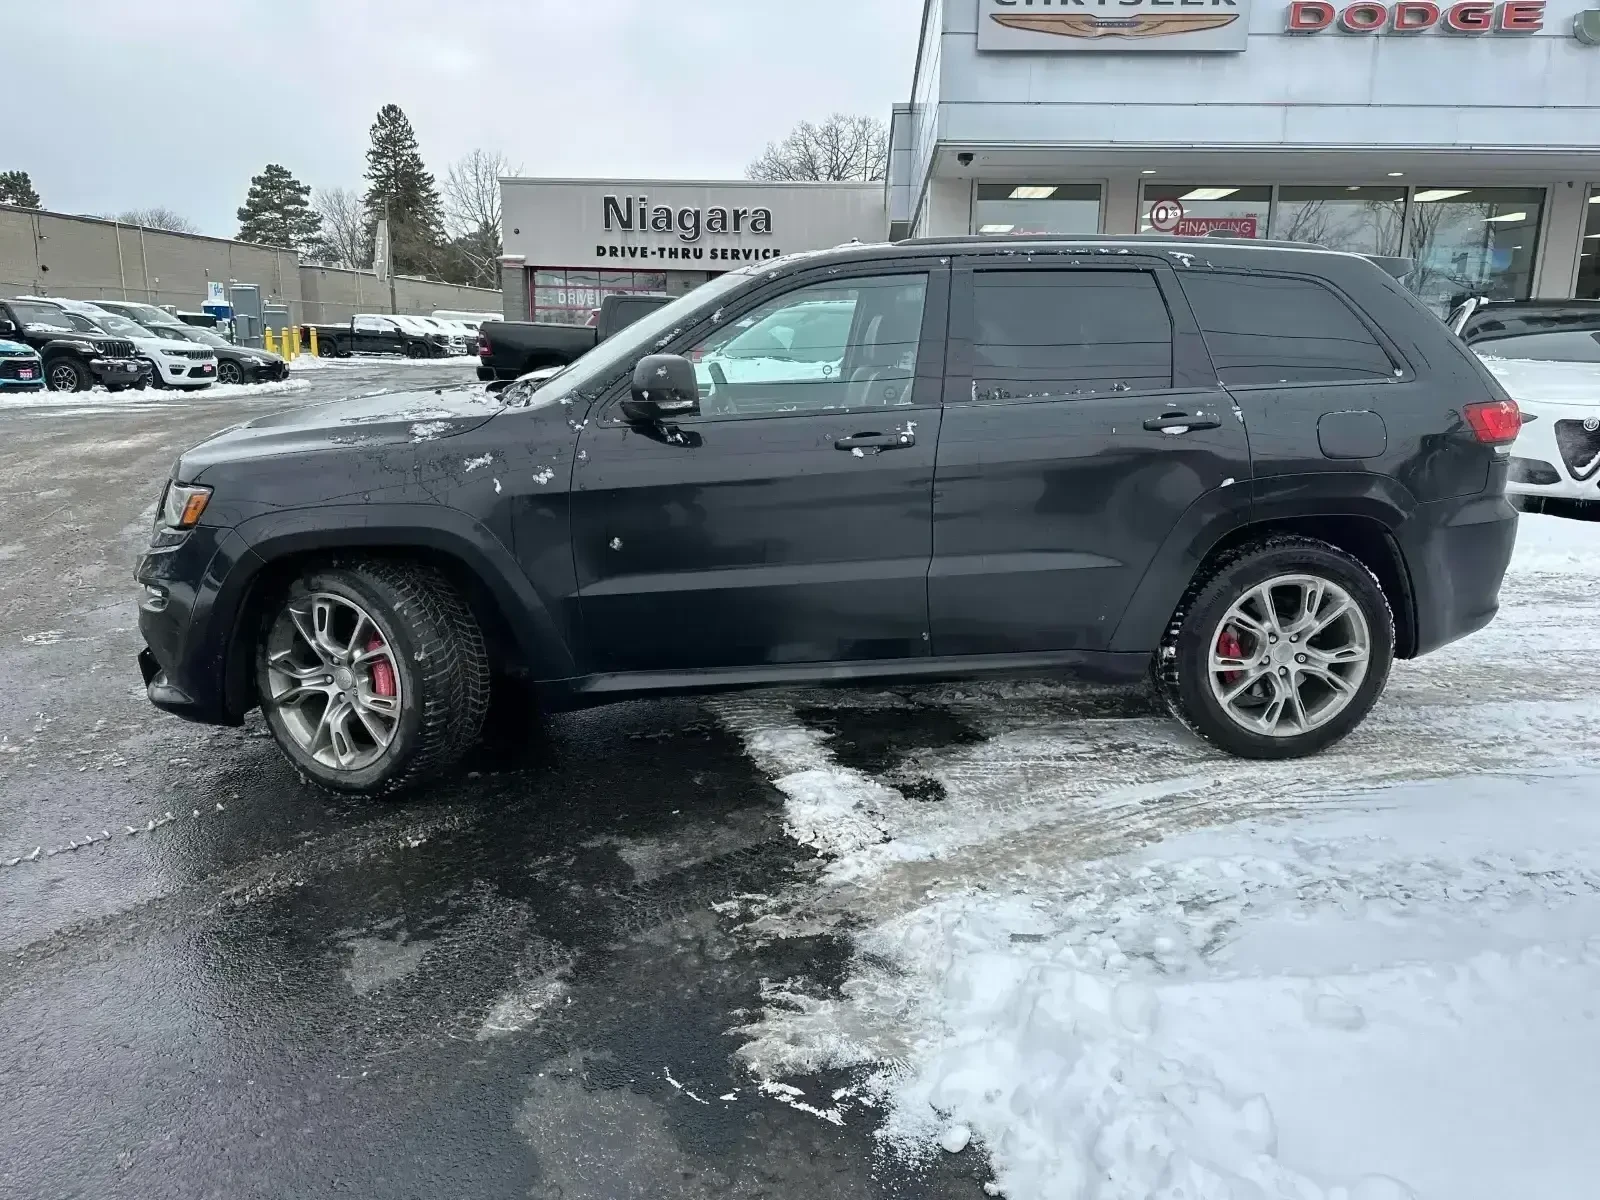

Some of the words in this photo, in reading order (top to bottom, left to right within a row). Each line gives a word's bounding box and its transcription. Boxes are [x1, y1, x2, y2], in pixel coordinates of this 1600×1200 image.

[1287, 0, 1547, 33] DODGE
[602, 195, 773, 242] Niagara
[1156, 206, 1178, 224] 0%
[1178, 221, 1251, 233] FINANCING
[596, 245, 703, 260] DRIVE-THRU
[709, 248, 781, 260] SERVICE
[558, 291, 595, 305] DRIVE
